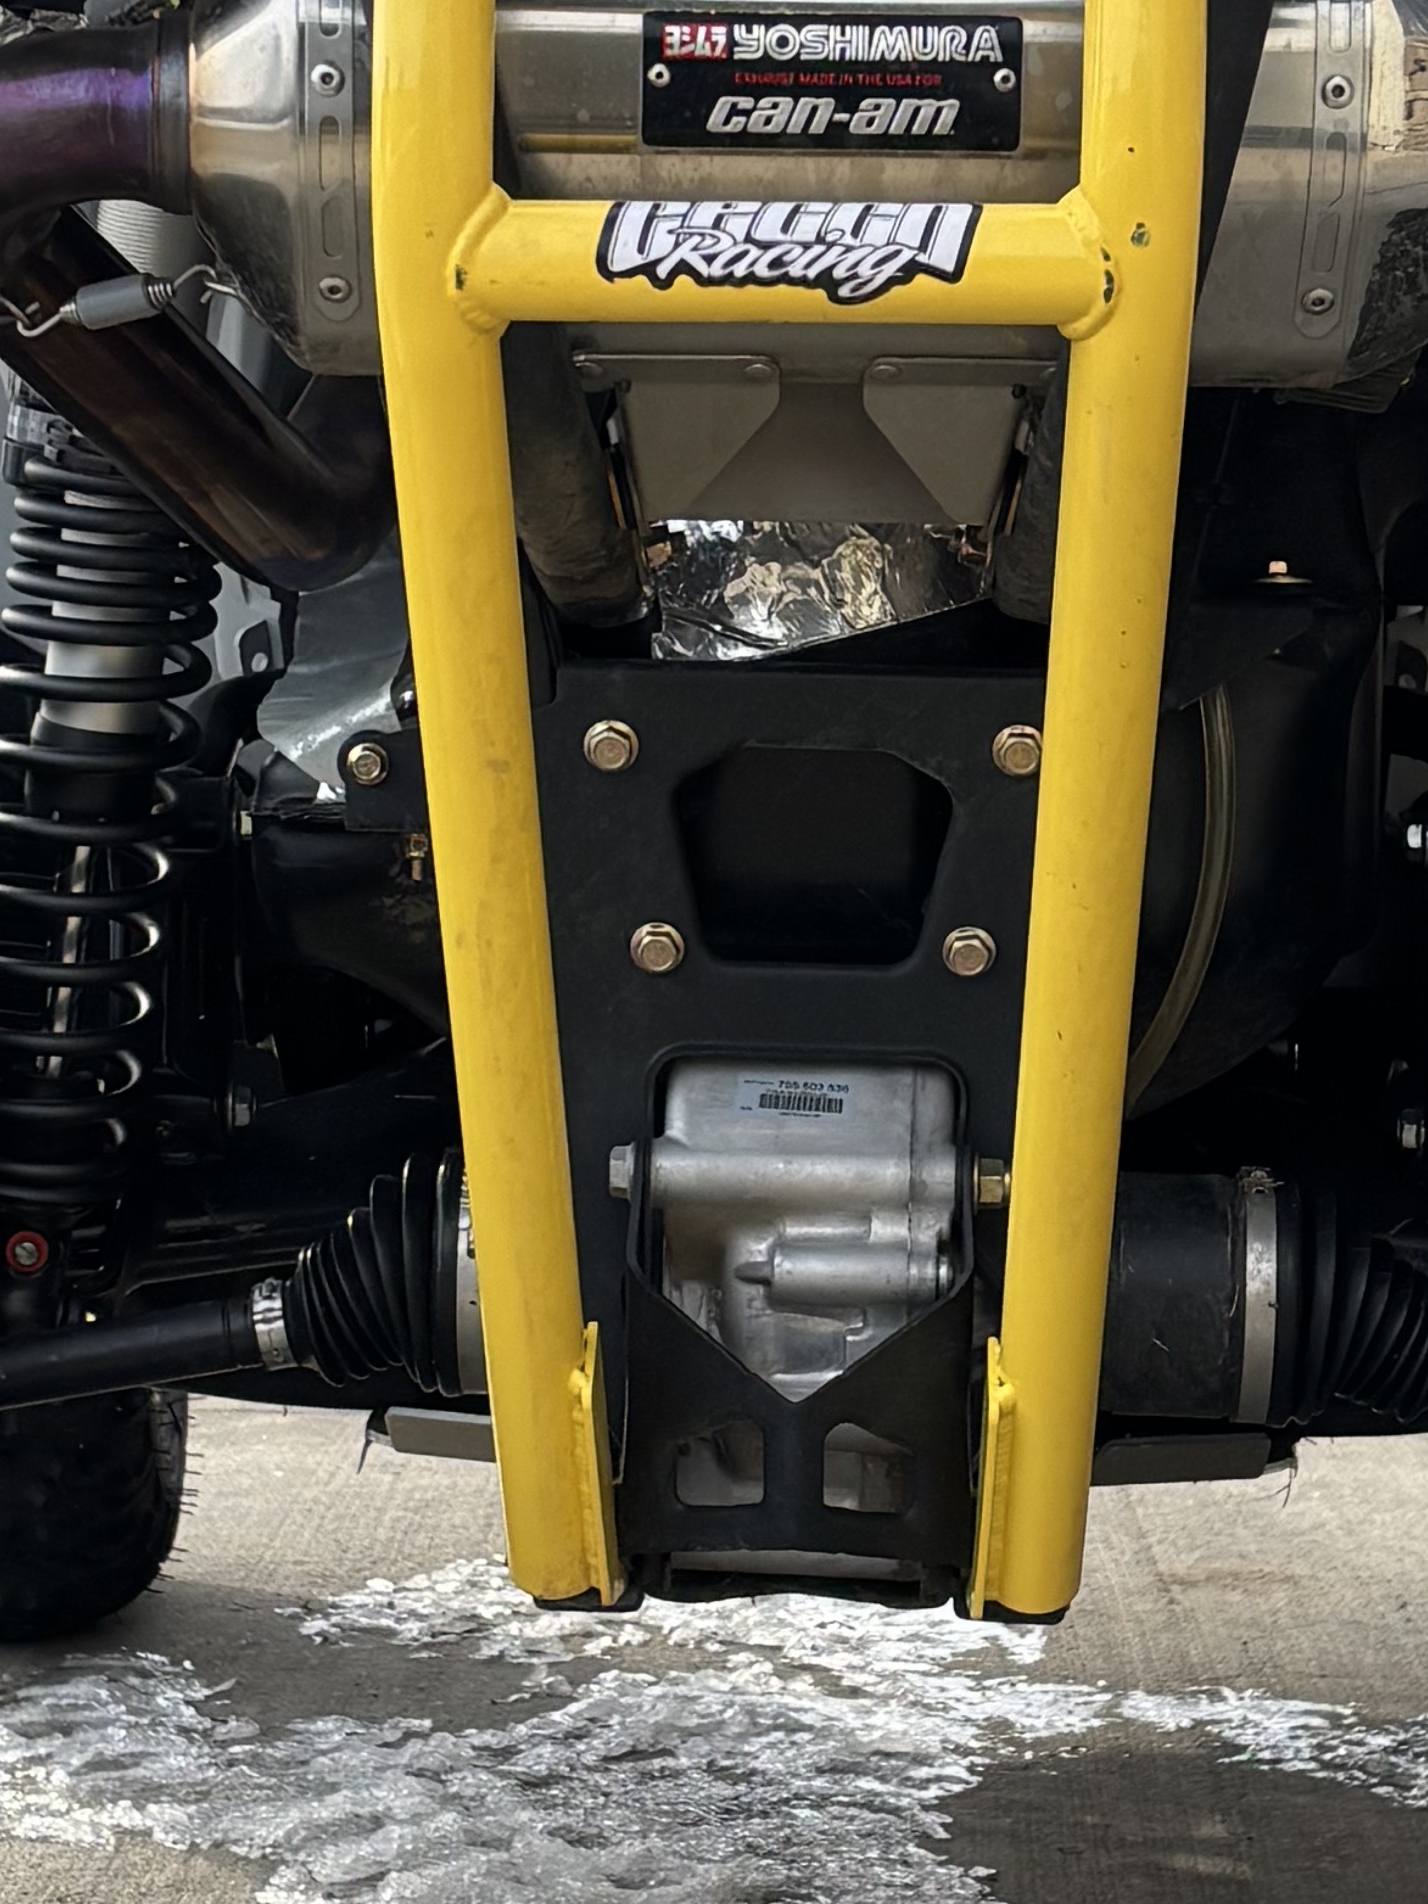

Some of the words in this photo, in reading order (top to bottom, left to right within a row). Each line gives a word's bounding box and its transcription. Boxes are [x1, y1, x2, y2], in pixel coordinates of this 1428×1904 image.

[663, 24, 727, 60] ヨシムラ
[733, 23, 1004, 62] YOSHIMURA
[799, 72, 836, 85] MADE
[856, 73, 883, 86] THE
[886, 73, 912, 86] USA
[705, 95, 960, 135] can-am
[656, 226, 920, 298] Racing
